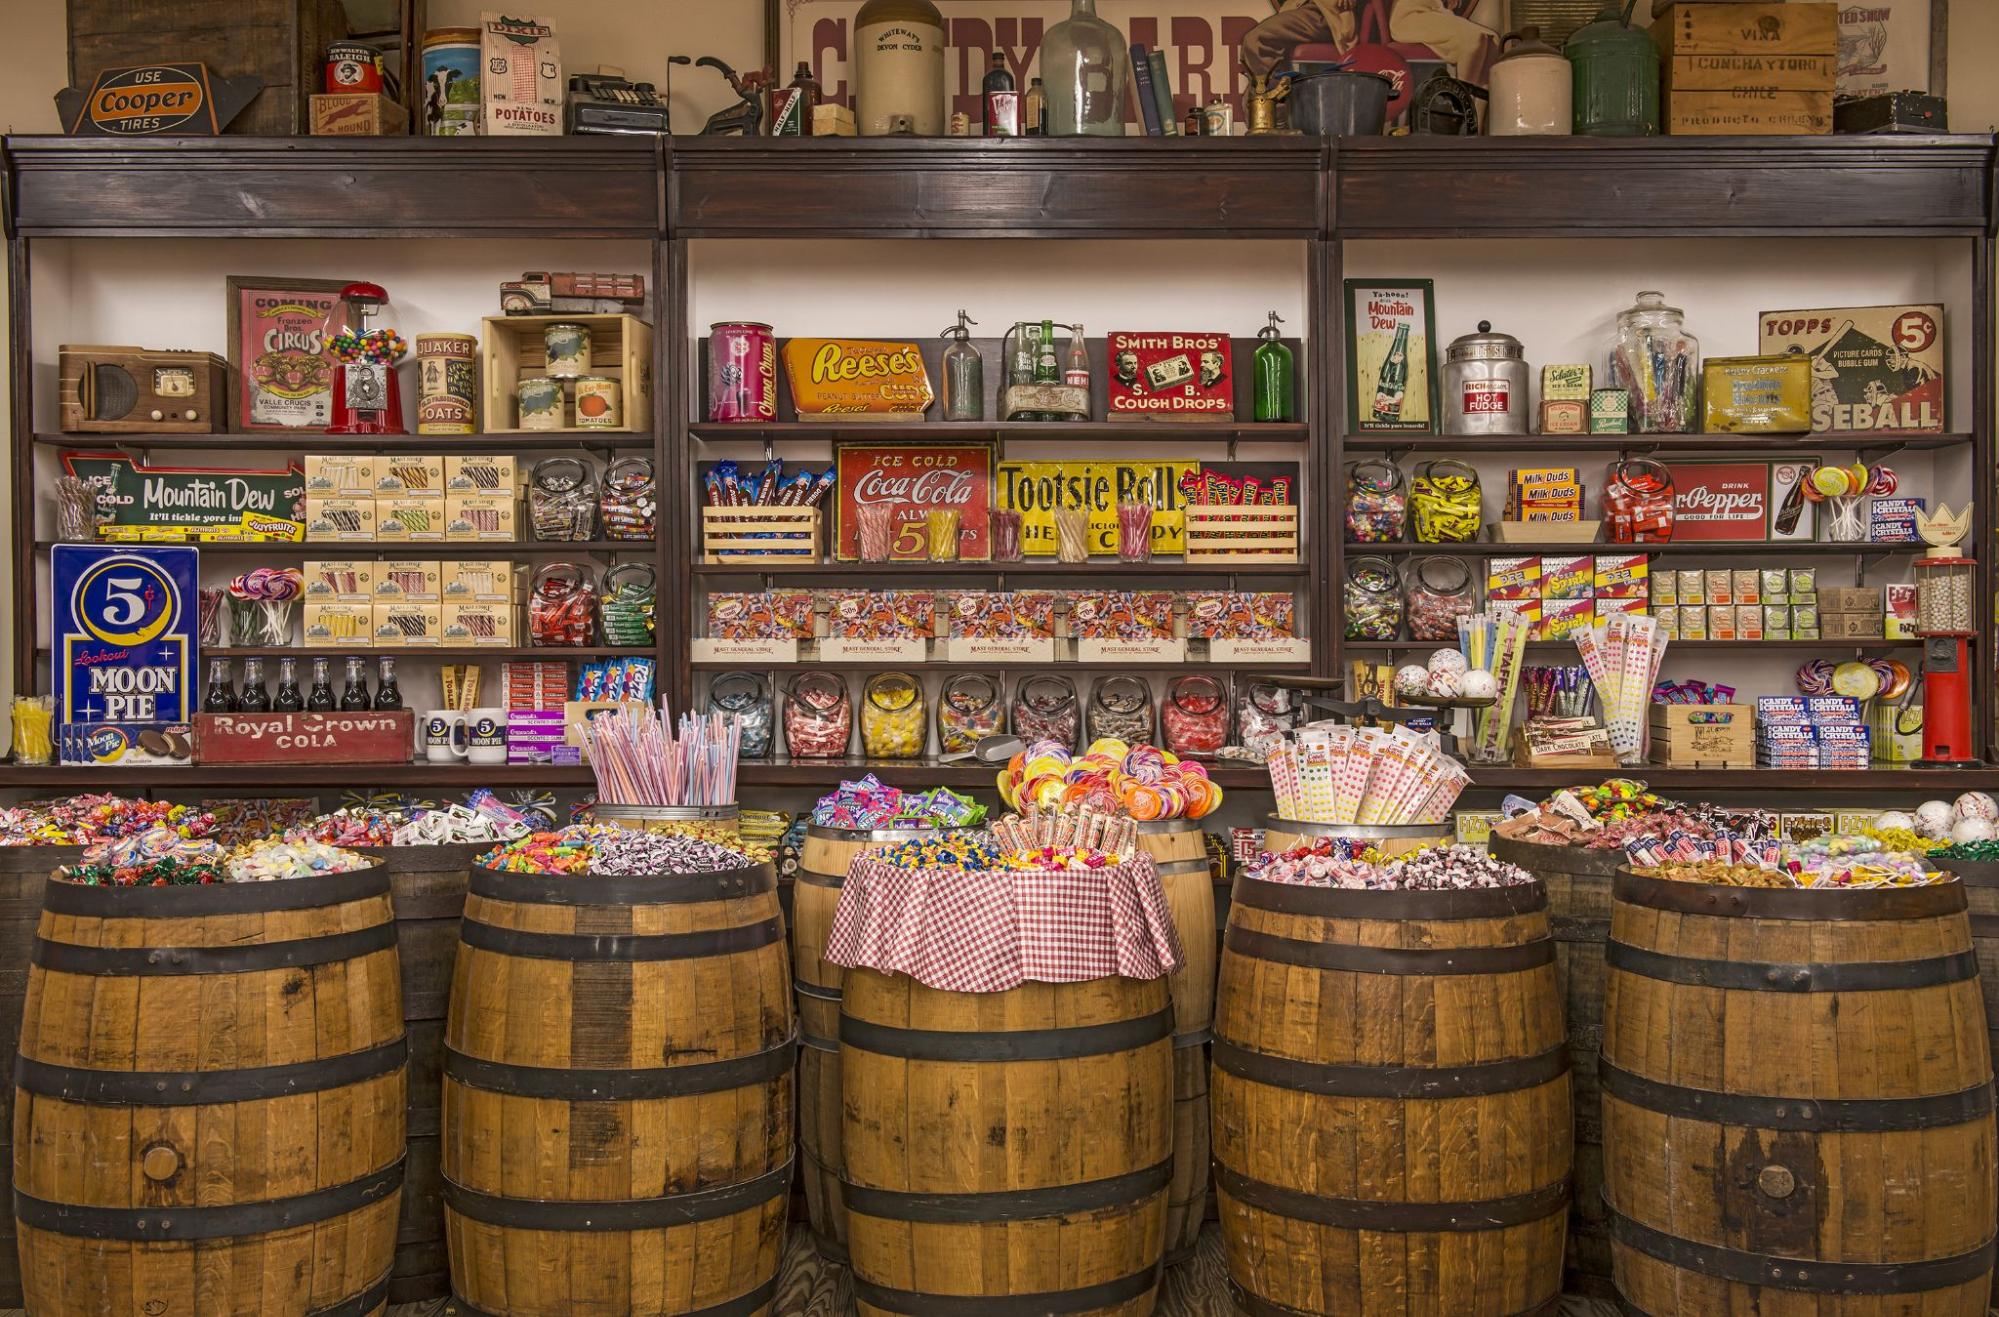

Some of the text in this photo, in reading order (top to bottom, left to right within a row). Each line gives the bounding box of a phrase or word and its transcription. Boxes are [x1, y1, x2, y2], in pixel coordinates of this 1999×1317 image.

[493, 24, 547, 35] DIXIE
[902, 43, 922, 51] CYDER
[329, 54, 371, 63] RALEIGH
[135, 71, 161, 84] USE
[812, 17, 1043, 124] CDY
[99, 89, 194, 114] Cooper
[495, 108, 556, 125] POTATOES
[120, 117, 161, 131] TIRES
[255, 298, 332, 310] COMING
[1367, 301, 1414, 316] Mountain
[1369, 316, 1396, 330] Dew
[1766, 317, 1833, 336] TOPPS
[263, 328, 323, 355] CIRCUS
[1116, 335, 1168, 349] SMITH
[1833, 348, 1883, 359] PICTURE CARDS
[811, 342, 920, 385] Reese's
[1838, 358, 1879, 367] BUBBLE GUM
[1133, 383, 1201, 396] S. B.
[1114, 396, 1226, 409] COUGH DROPS
[1475, 393, 1497, 402] HOT
[1469, 401, 1504, 410] FUDGE
[425, 408, 463, 420] OATS
[1811, 401, 1939, 431] SEBALL
[872, 456, 958, 467] ICE COLD
[1523, 471, 1569, 485] Milk Duds
[853, 468, 976, 505] Coca-Cola
[999, 466, 1111, 513] Tootsie
[1528, 487, 1575, 500] Milk Duds
[96, 495, 134, 505] COLD
[143, 478, 275, 511] Mountain Dew
[1676, 485, 1763, 514] r. Pepper
[149, 512, 167, 521] It'll
[168, 512, 201, 521] tickle
[203, 513, 224, 523] yore
[1528, 510, 1574, 523] Milk Duds
[892, 521, 928, 554] 5
[74, 648, 130, 667] Lookout
[89, 667, 176, 693] MOON
[104, 695, 155, 720] PIE
[214, 714, 397, 740] Royal Crown
[432, 720, 442, 732] 5
[480, 720, 491, 733] 5
[86, 731, 115, 748] Moon
[104, 738, 120, 751] Pie
[276, 735, 337, 749] COLA
[471, 737, 491, 745] MOON
[1535, 741, 1585, 753] DARK CHOCOLATE
